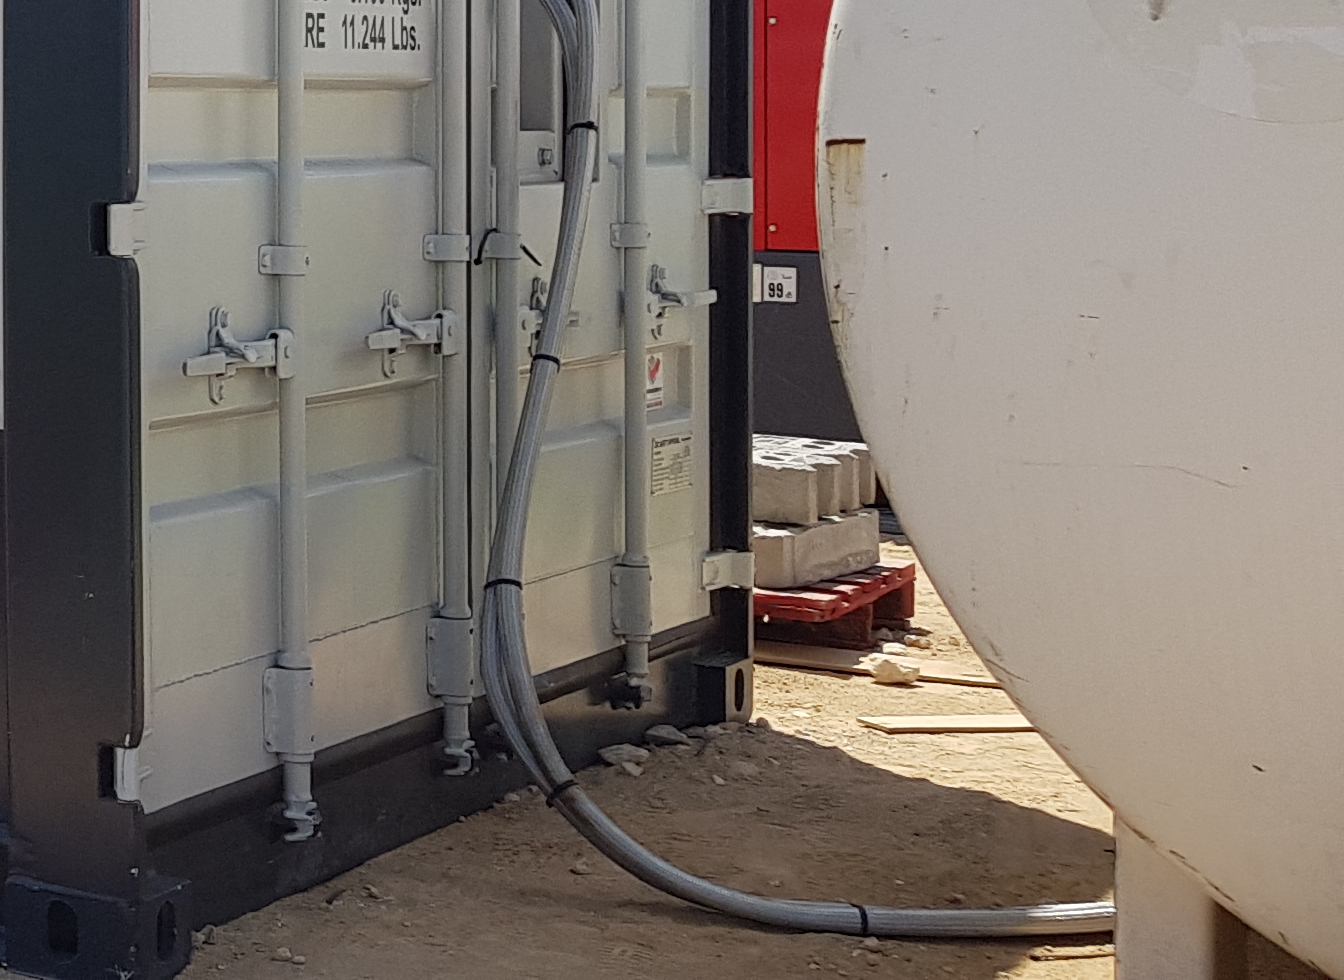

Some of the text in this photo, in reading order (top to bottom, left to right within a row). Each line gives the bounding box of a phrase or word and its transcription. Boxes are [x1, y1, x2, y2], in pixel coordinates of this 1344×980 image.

[304, 12, 421, 51] RE 11.244 Lbs.
[768, 282, 784, 299] 99
